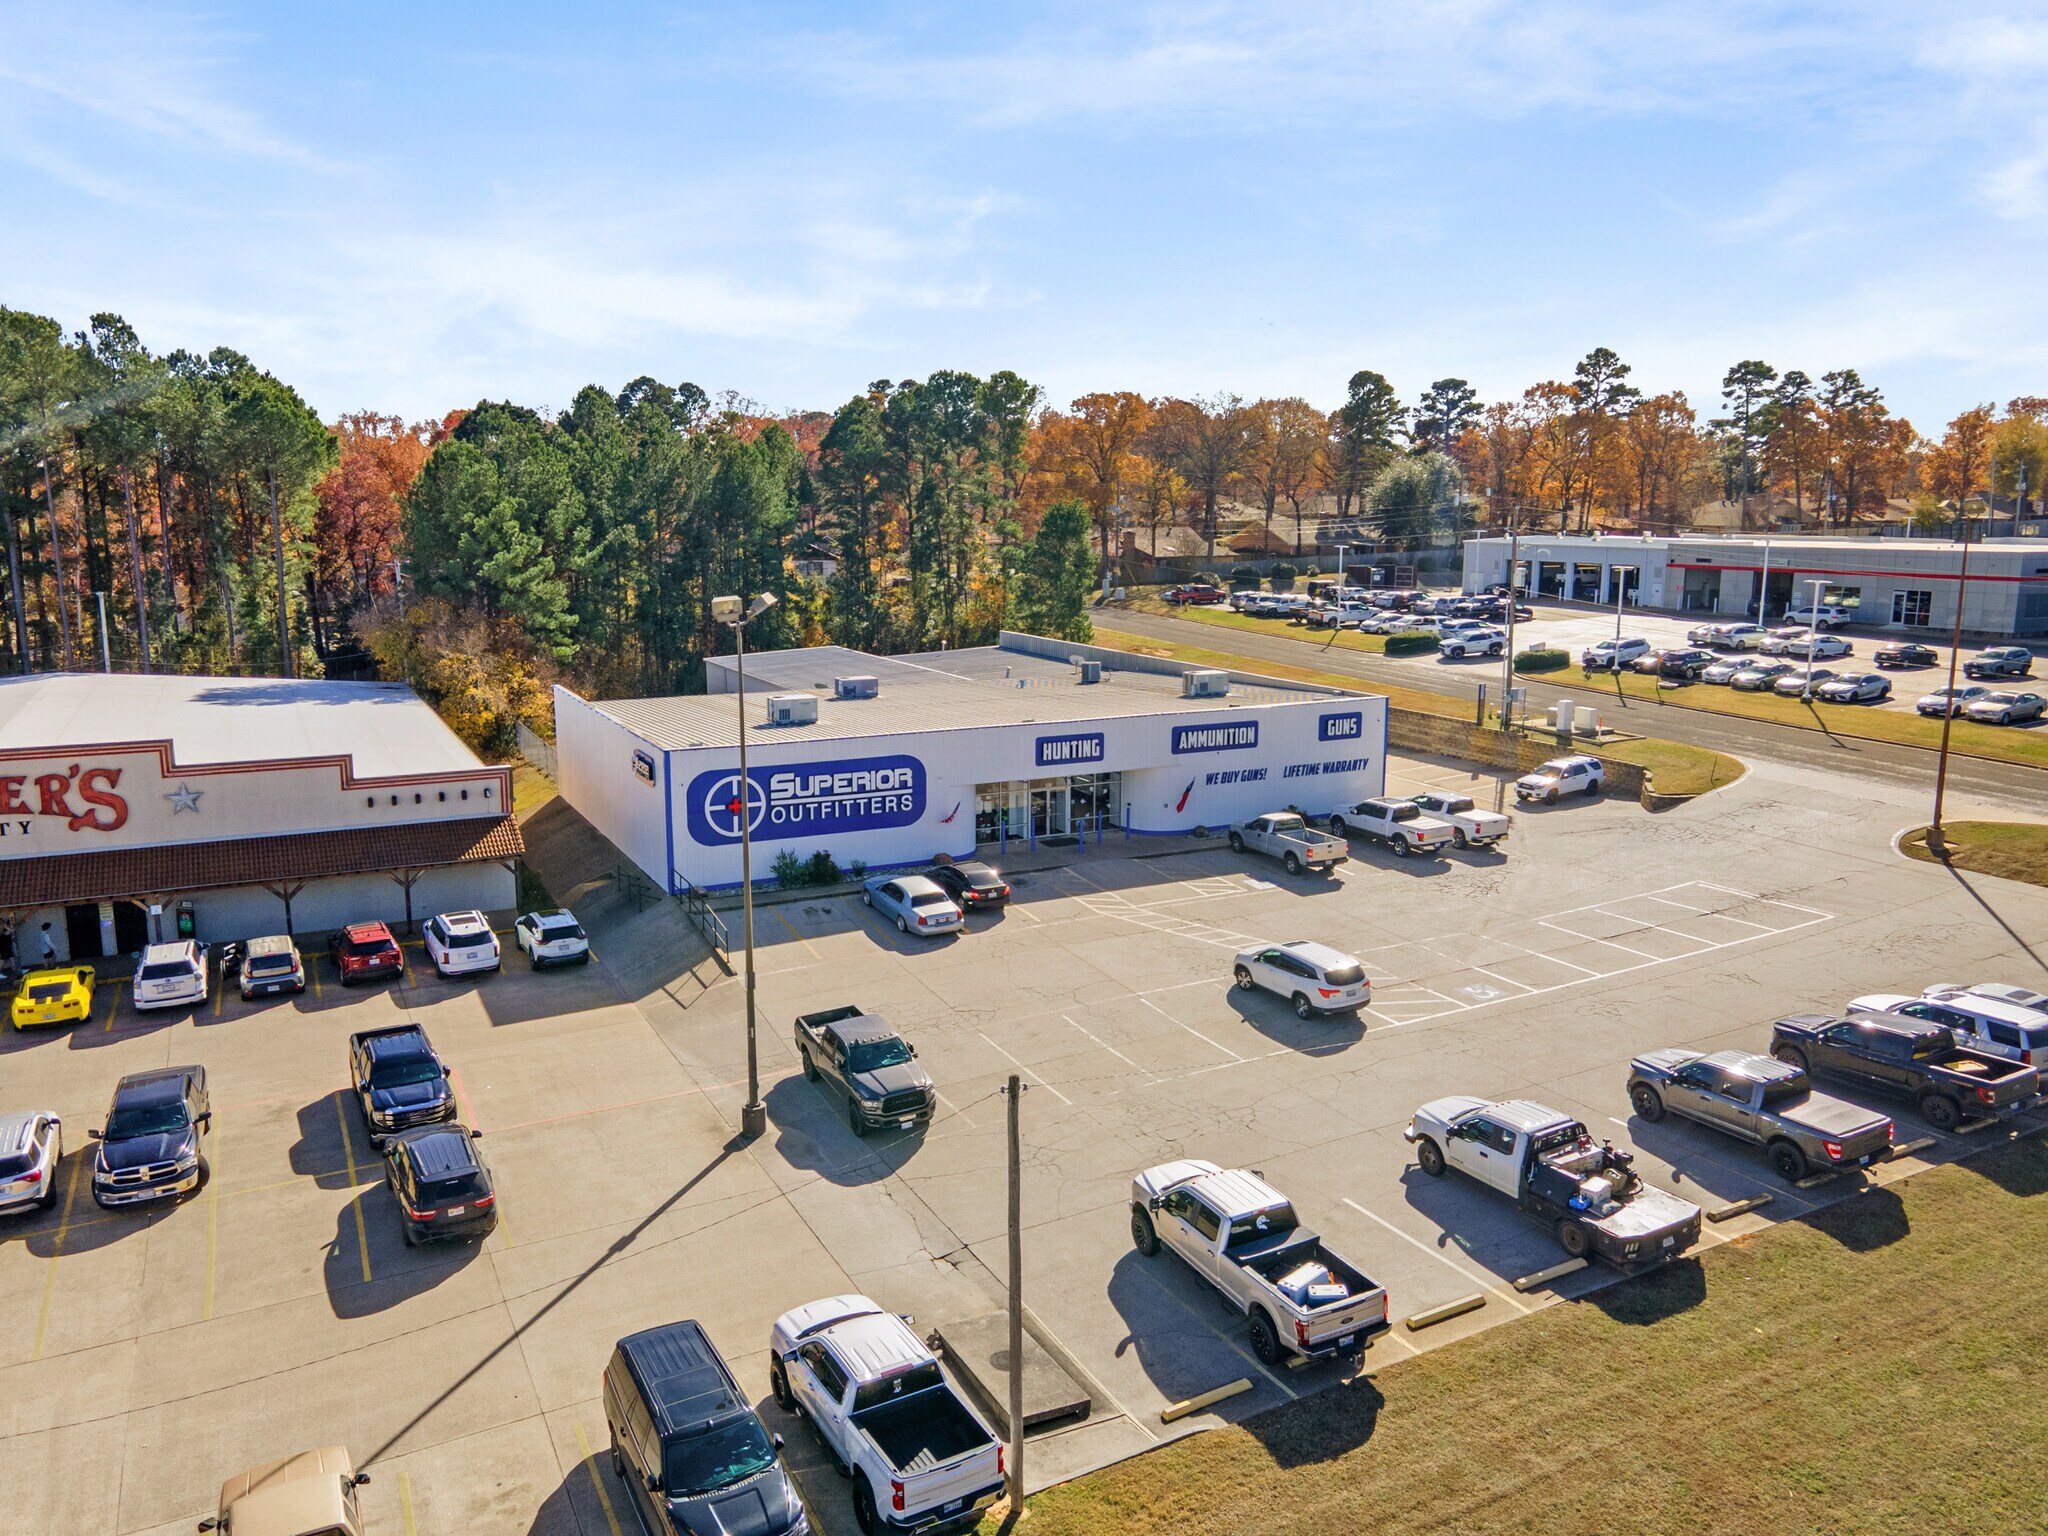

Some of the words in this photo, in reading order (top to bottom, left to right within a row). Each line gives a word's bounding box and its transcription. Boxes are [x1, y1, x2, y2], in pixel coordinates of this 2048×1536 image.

[1179, 727, 1255, 749] AMMUNITION
[1327, 718, 1357, 736] GUNS
[1043, 739, 1100, 761] HUNTING
[1206, 772, 1220, 785] WE
[1220, 770, 1240, 784] BUY
[1240, 768, 1268, 782] GUNS!
[1283, 763, 1321, 778] LIFETIME
[1322, 758, 1369, 774] WARRANTY
[770, 768, 912, 800] SUPERIOR
[771, 795, 912, 823] OUTFITTERS
